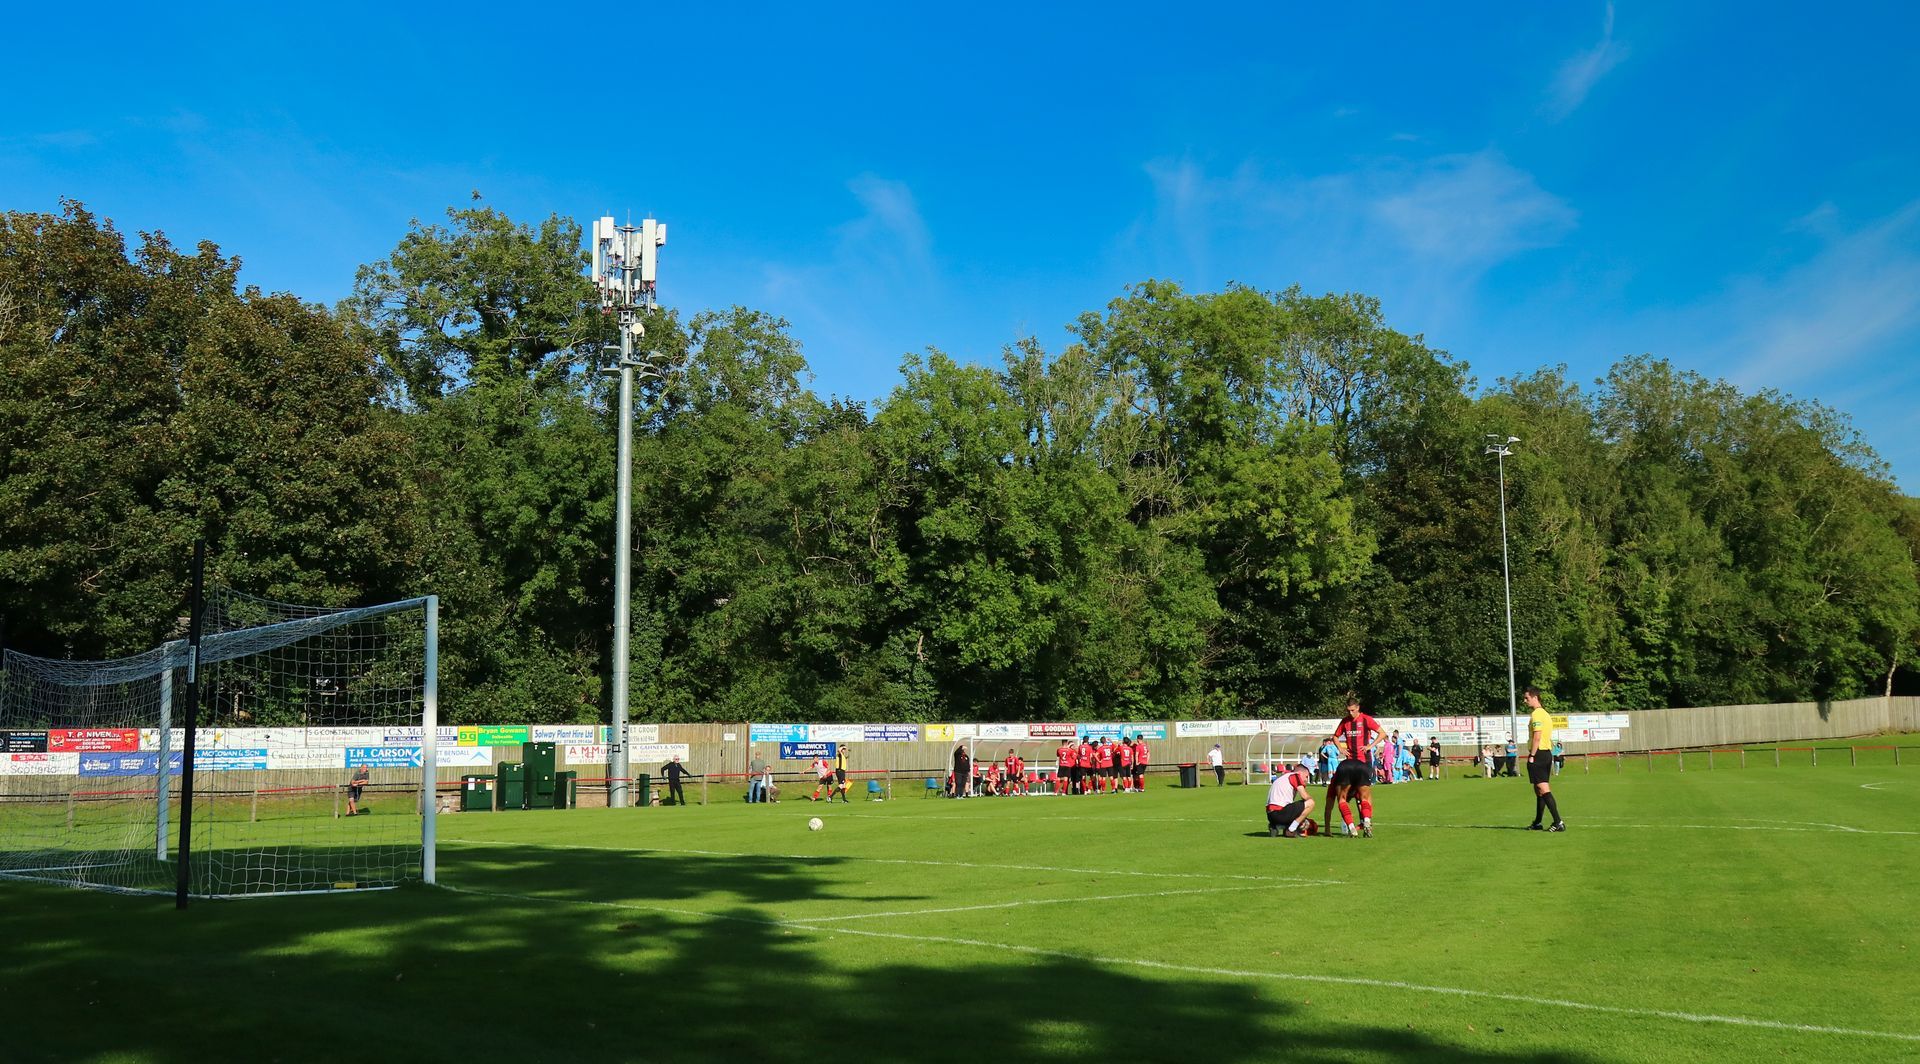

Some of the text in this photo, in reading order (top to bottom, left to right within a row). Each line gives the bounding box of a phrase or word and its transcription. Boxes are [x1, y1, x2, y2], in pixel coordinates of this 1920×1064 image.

[1420, 718, 1435, 728] RBS
[478, 727, 498, 735] Bryan
[534, 728, 594, 740] Solway Plant Hire Ltd
[370, 748, 412, 758] CARSON
[1062, 752, 1066, 760] 2
[1082, 748, 1086, 756] 8
[10, 764, 57, 774] Scotland
